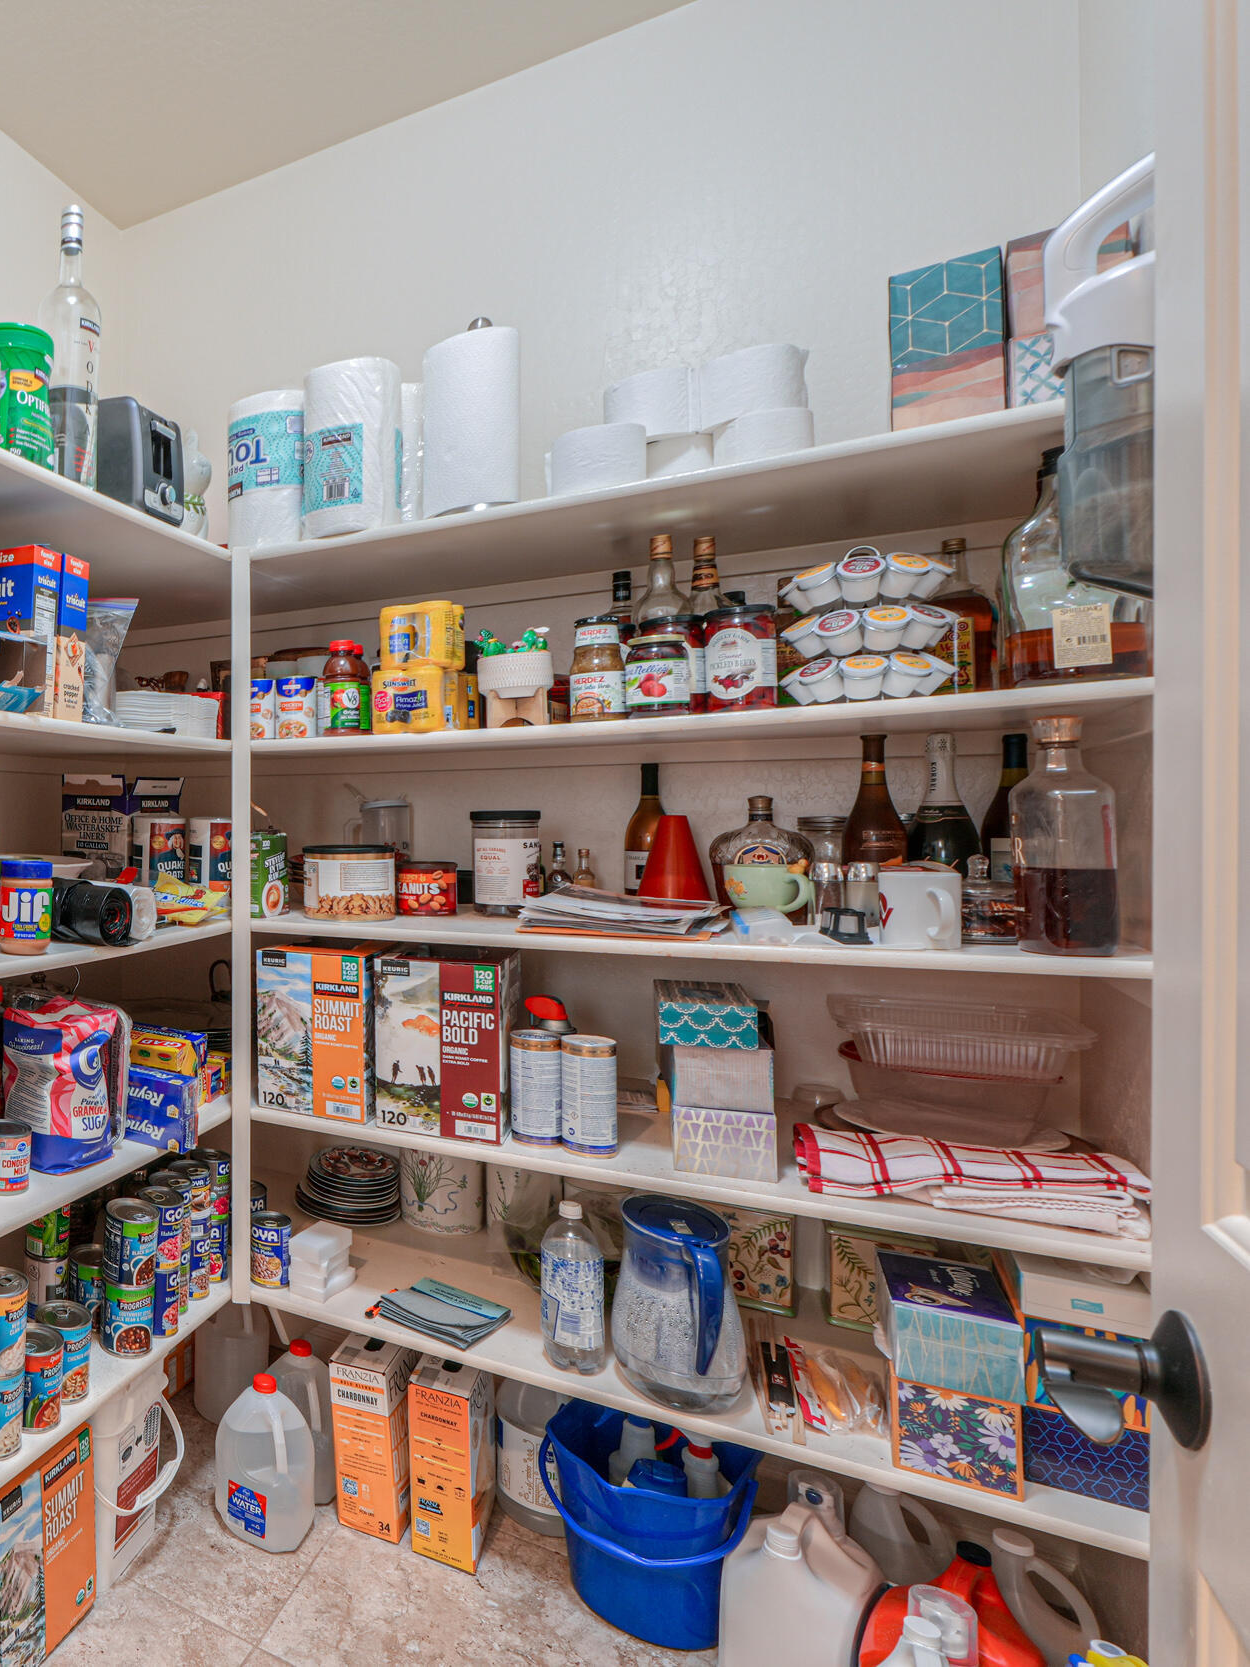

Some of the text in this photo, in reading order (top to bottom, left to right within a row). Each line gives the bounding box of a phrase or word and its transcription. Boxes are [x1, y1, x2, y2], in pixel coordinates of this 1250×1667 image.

[38, 574, 56, 588] triscuit
[66, 594, 86, 608] triscuit
[579, 628, 609, 636] HERDEZ
[574, 676, 605, 686] HERDEZ
[346, 692, 358, 705] V8
[76, 797, 111, 807] KIRKLAND
[141, 800, 169, 808] KIRKLAND
[65, 813, 123, 826] OFFICE & HOME
[66, 823, 121, 834] WASTEBASKET
[79, 832, 106, 841] LINERS
[84, 842, 108, 850] GALLON
[157, 860, 185, 871] QUAKE
[399, 882, 440, 895] EANUTS
[2, 891, 50, 923] Jif
[342, 962, 357, 971] 120
[475, 970, 492, 979] 120
[315, 982, 358, 993] KIRKLAND
[444, 992, 493, 1003] KIRKLAND
[314, 999, 361, 1018] SUMMIT
[314, 1014, 352, 1033] ROAST
[442, 1009, 495, 1030] PACIFIC
[141, 1039, 183, 1048] GLAD
[442, 1028, 478, 1045] BOLD
[442, 1045, 469, 1055] ORGANIC
[129, 1086, 165, 1108] Reyn
[262, 1090, 285, 1106] 120
[381, 1109, 407, 1126] 120
[1, 1157, 31, 1169] CONDENS
[13, 1166, 27, 1176] MILK
[252, 1227, 279, 1243] OYA
[336, 1366, 380, 1384] FRANZIA
[337, 1388, 379, 1407] CHARDONNAY
[415, 1388, 462, 1410] FRANZIA
[420, 1411, 458, 1428] CHARDONNAY
[80, 1436, 90, 1450] 120
[44, 1450, 77, 1484] KIRKLAND
[44, 1469, 85, 1523] SUMMIT
[2, 1497, 23, 1517] KEURIG
[231, 1495, 262, 1517] WATER
[45, 1500, 79, 1546] ROAST
[378, 1521, 391, 1534] 34
